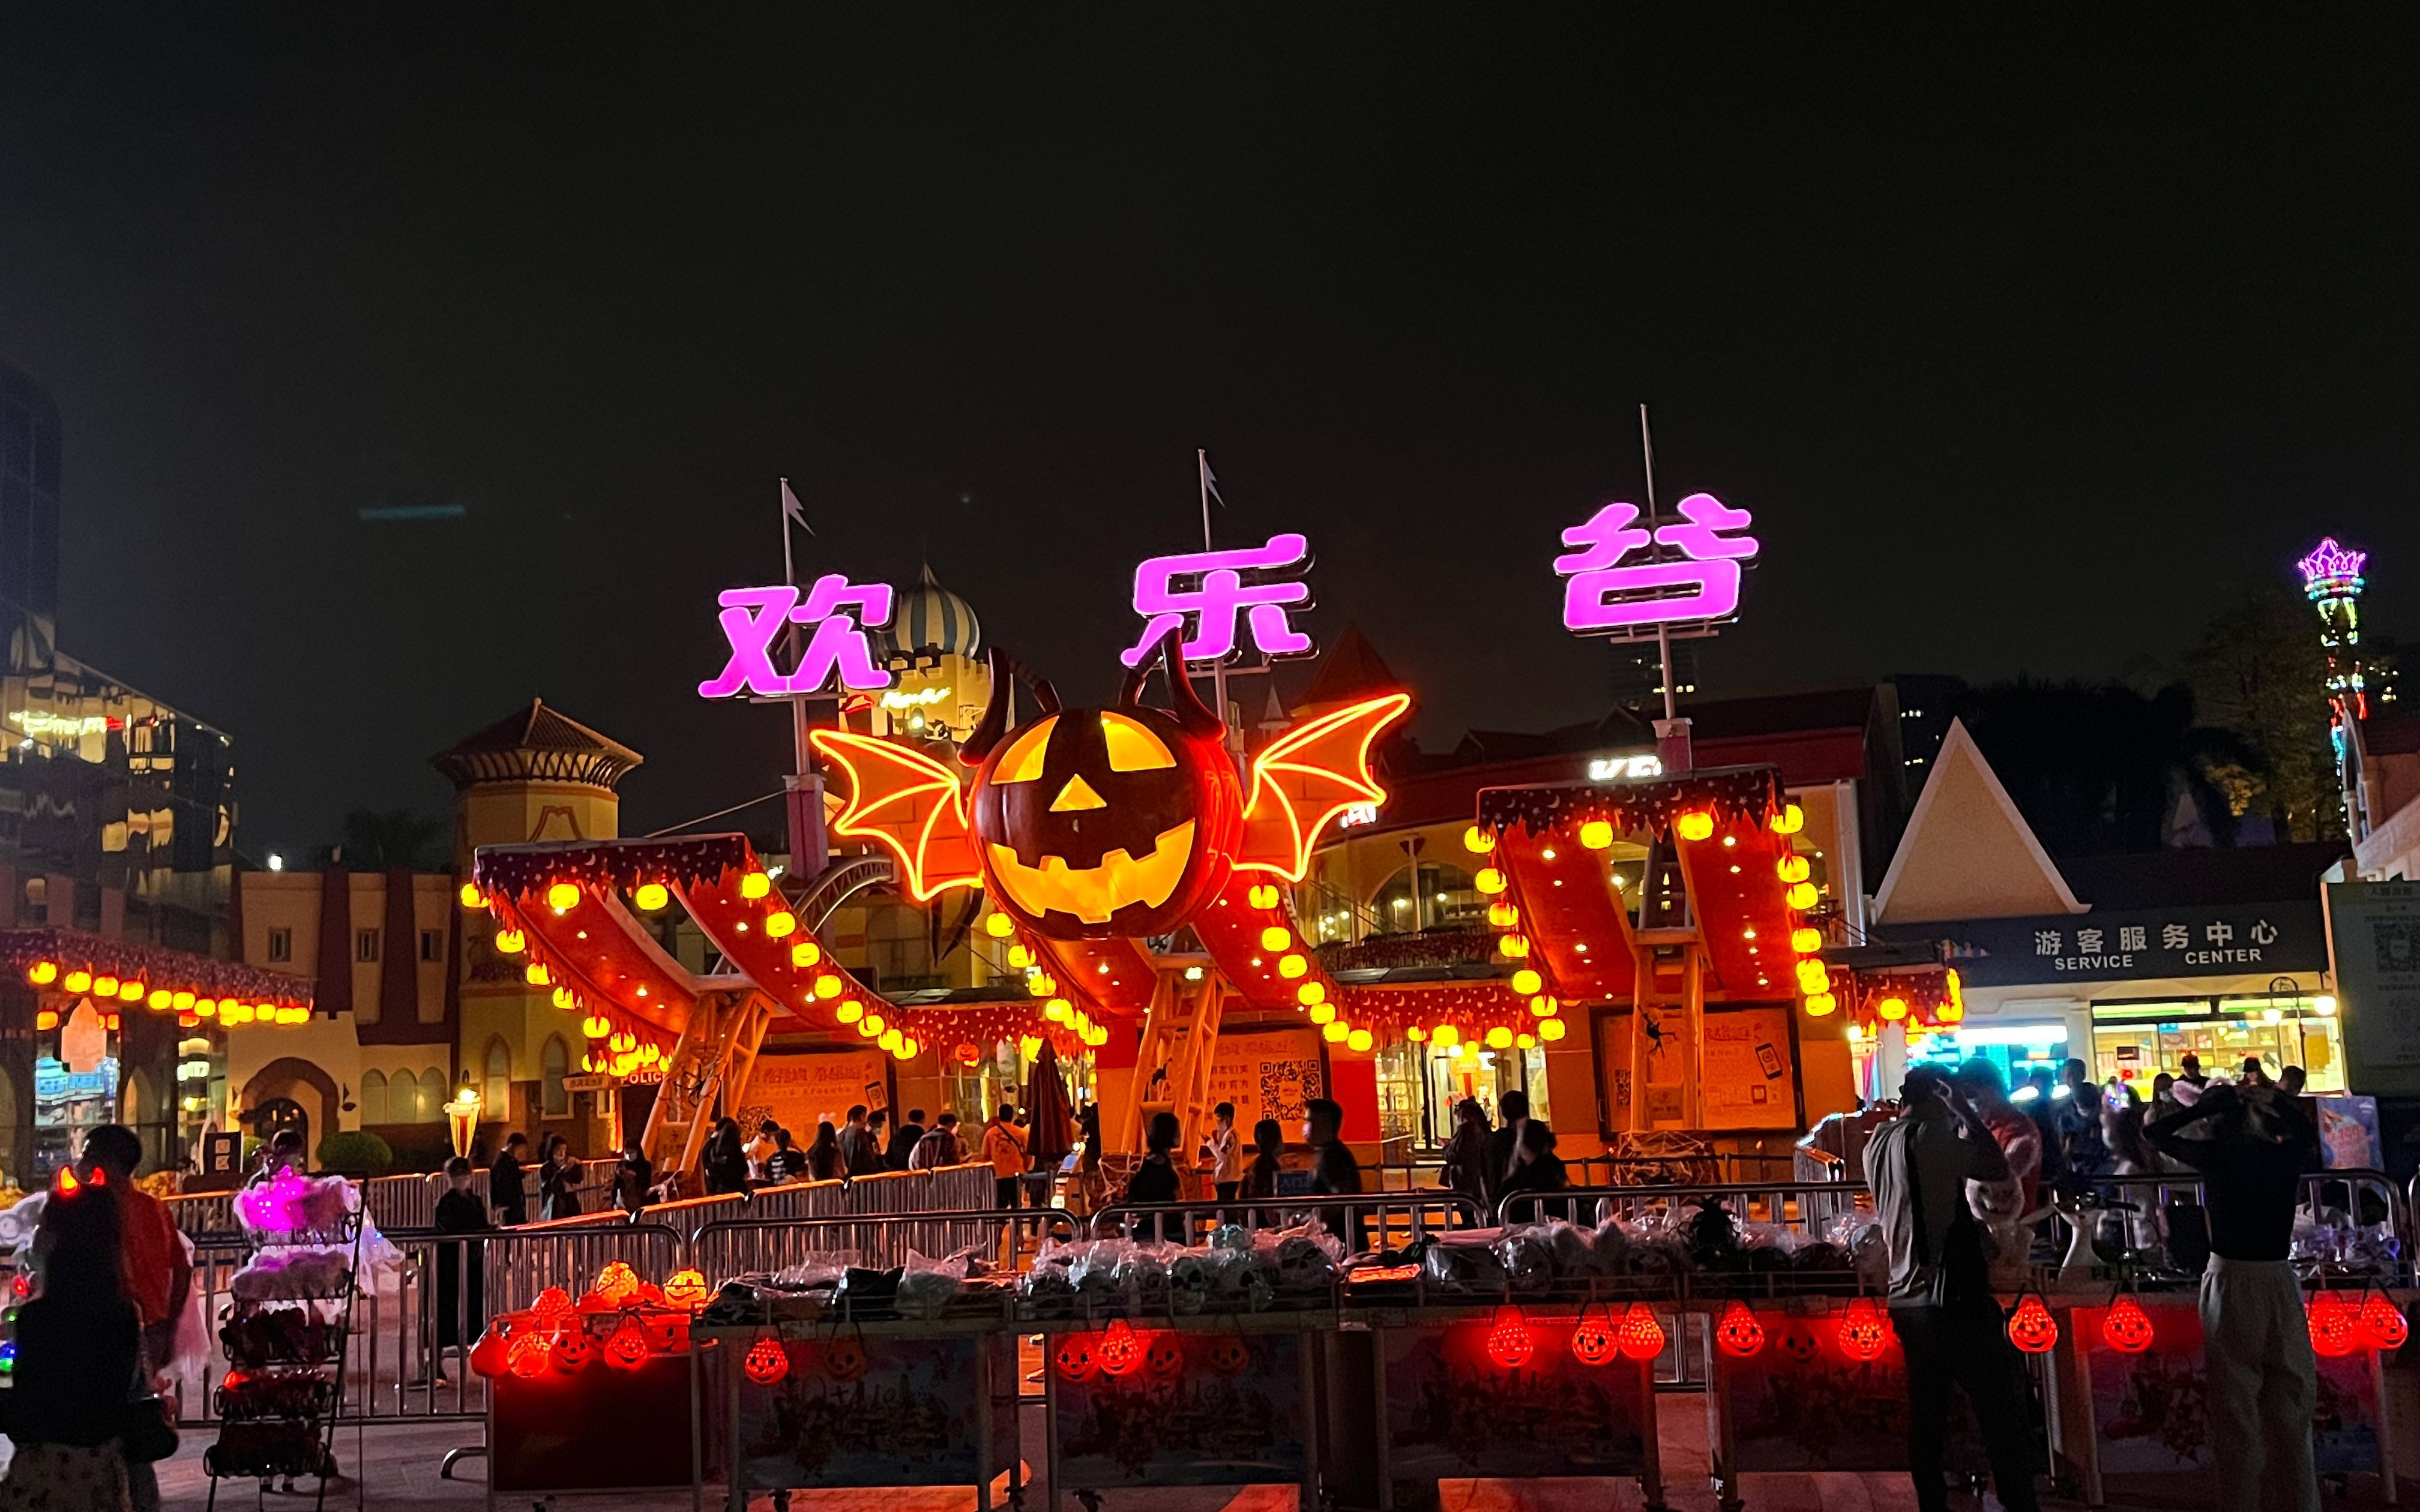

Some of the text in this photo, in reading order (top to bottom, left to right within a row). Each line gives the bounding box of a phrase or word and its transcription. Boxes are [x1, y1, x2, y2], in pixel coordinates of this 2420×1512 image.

[698, 493, 1759, 698] 欢 乐 谷
[2035, 919, 2279, 956] 游客服务中心
[2054, 948, 2262, 970] SERVICE CENTER
